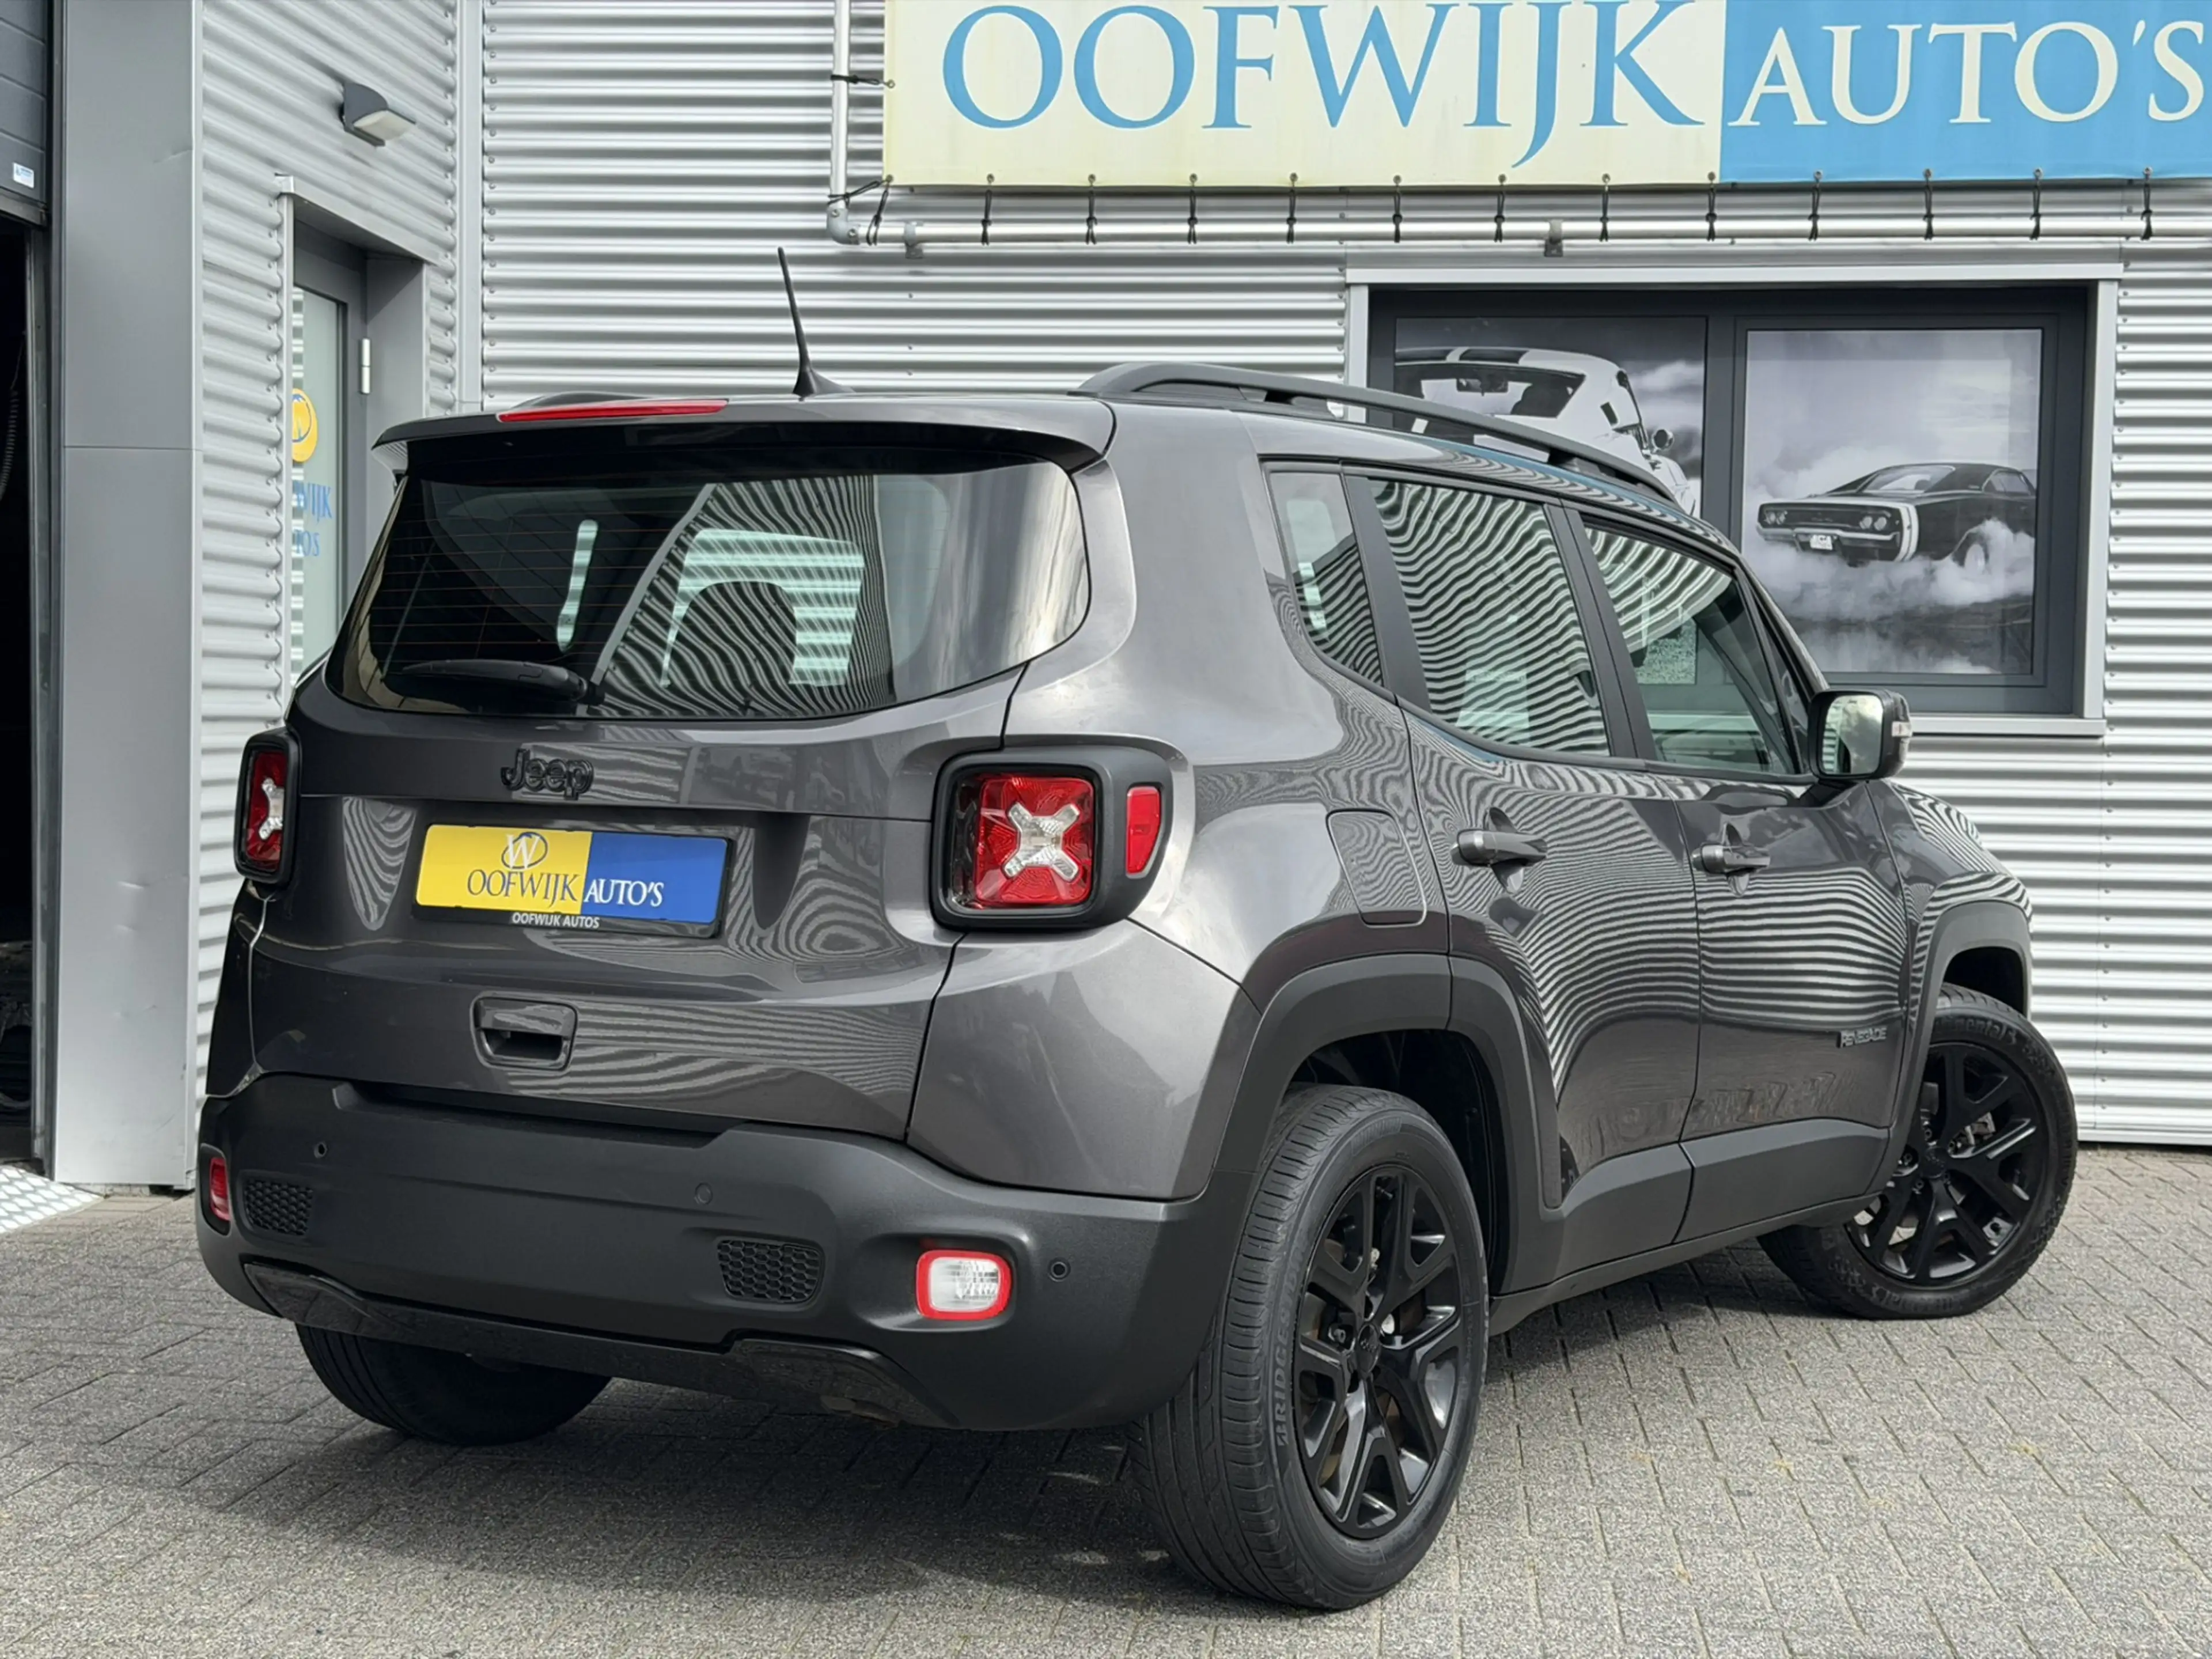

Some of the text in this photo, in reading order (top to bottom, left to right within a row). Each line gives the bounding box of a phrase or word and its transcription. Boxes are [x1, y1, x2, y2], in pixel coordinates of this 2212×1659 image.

[942, 0, 2205, 168] OOFWIJK AUTO'S
[501, 748, 594, 800] Jeep
[467, 869, 664, 908] OOFWIJK AUTO'S
[512, 912, 600, 929] OOFWIJK AUTOS
